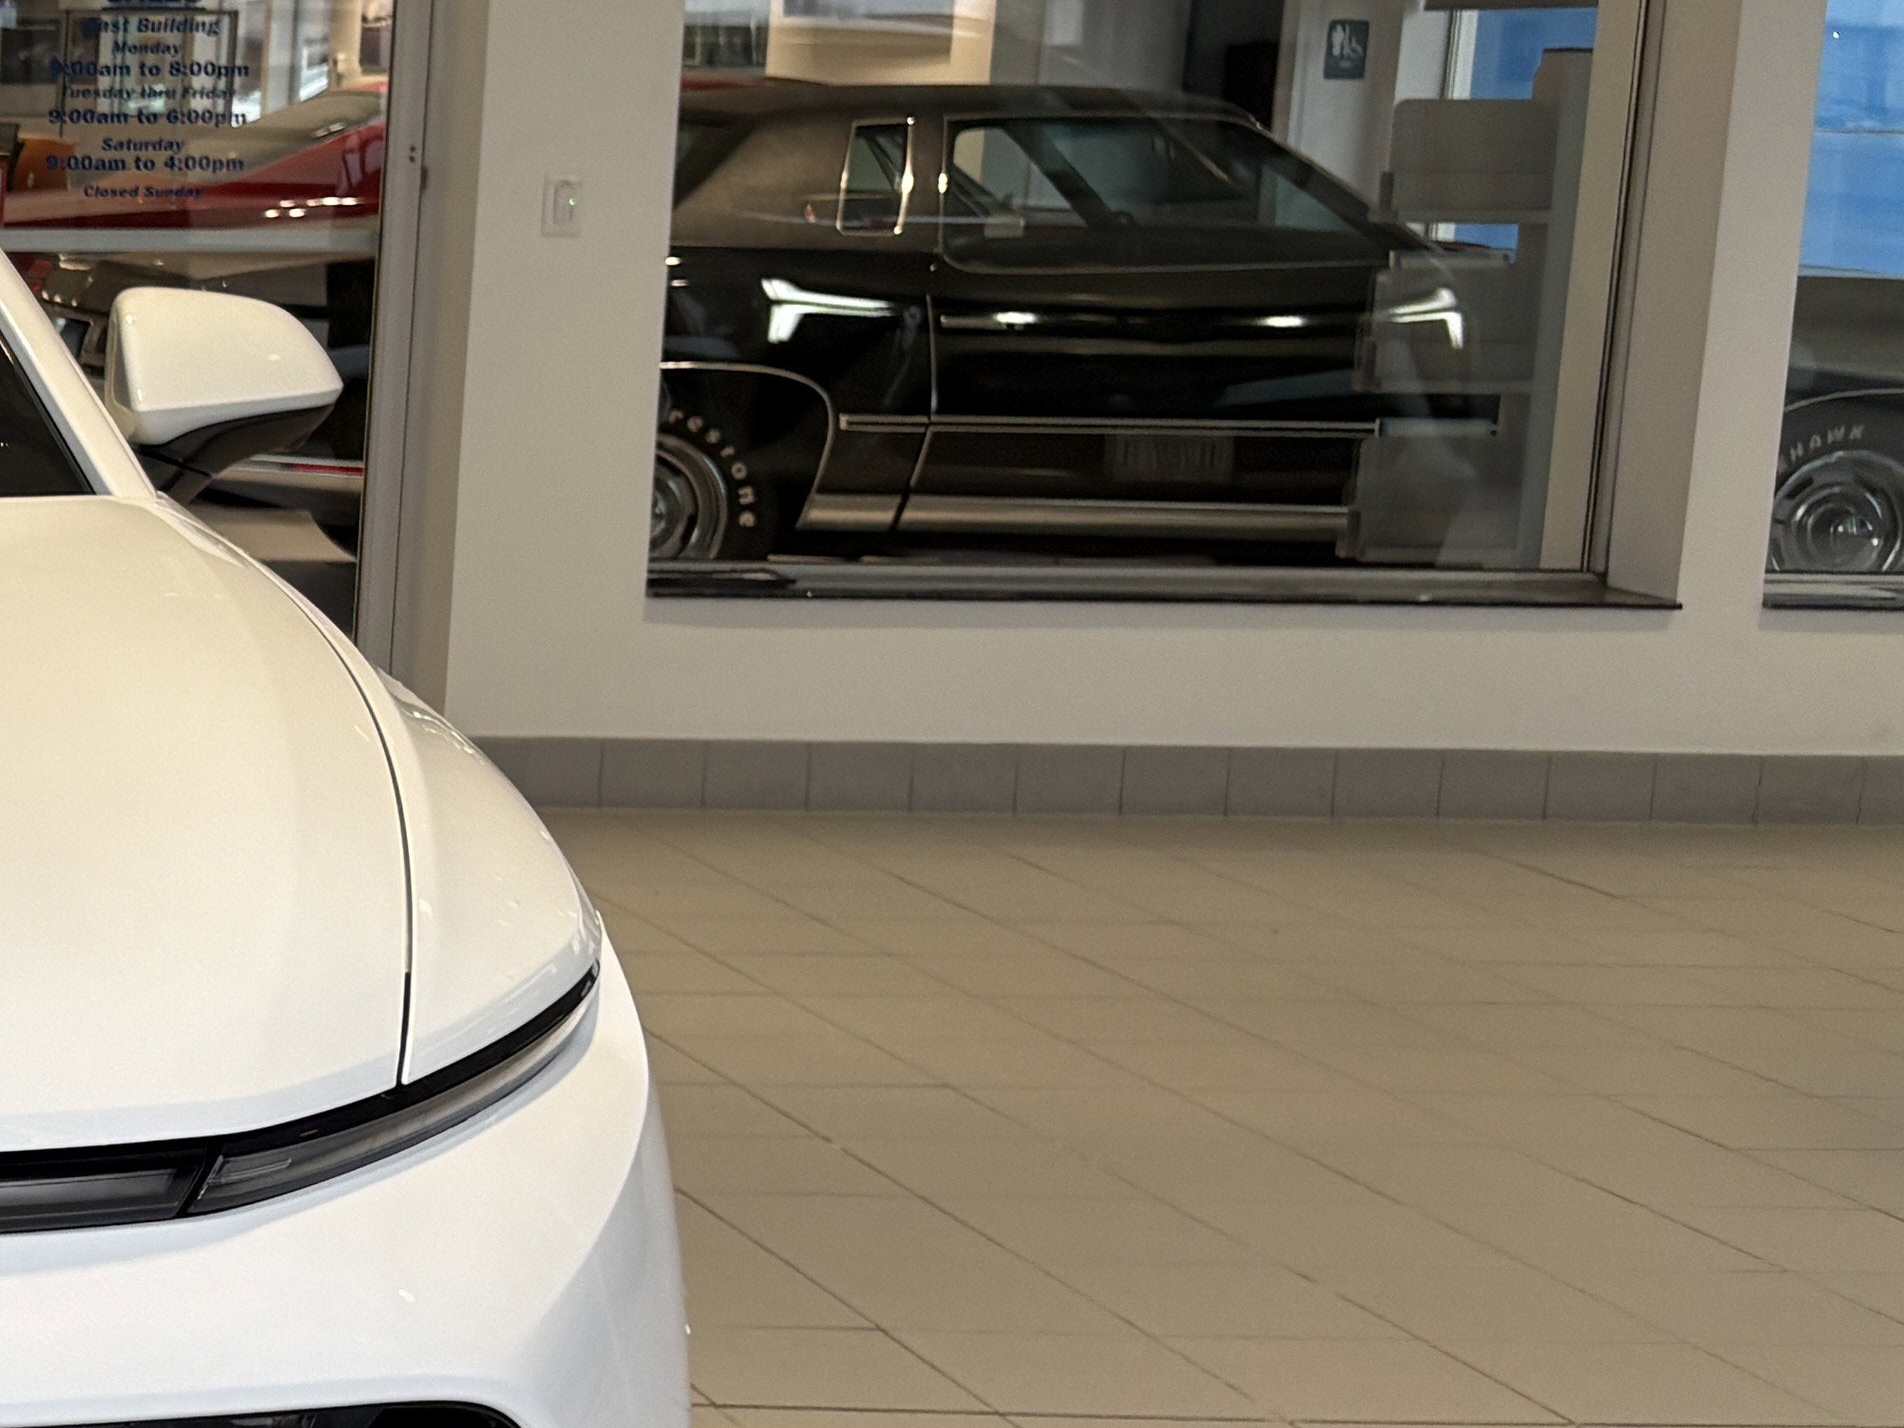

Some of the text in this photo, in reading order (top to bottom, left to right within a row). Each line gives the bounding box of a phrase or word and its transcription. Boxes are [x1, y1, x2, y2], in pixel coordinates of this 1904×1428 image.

[137, 17, 222, 37] Building
[140, 62, 161, 77] to
[137, 110, 159, 125] to
[101, 138, 185, 154] Saturday
[135, 156, 156, 171] to
[164, 155, 246, 174] 4:00pm
[83, 186, 139, 198] Closed
